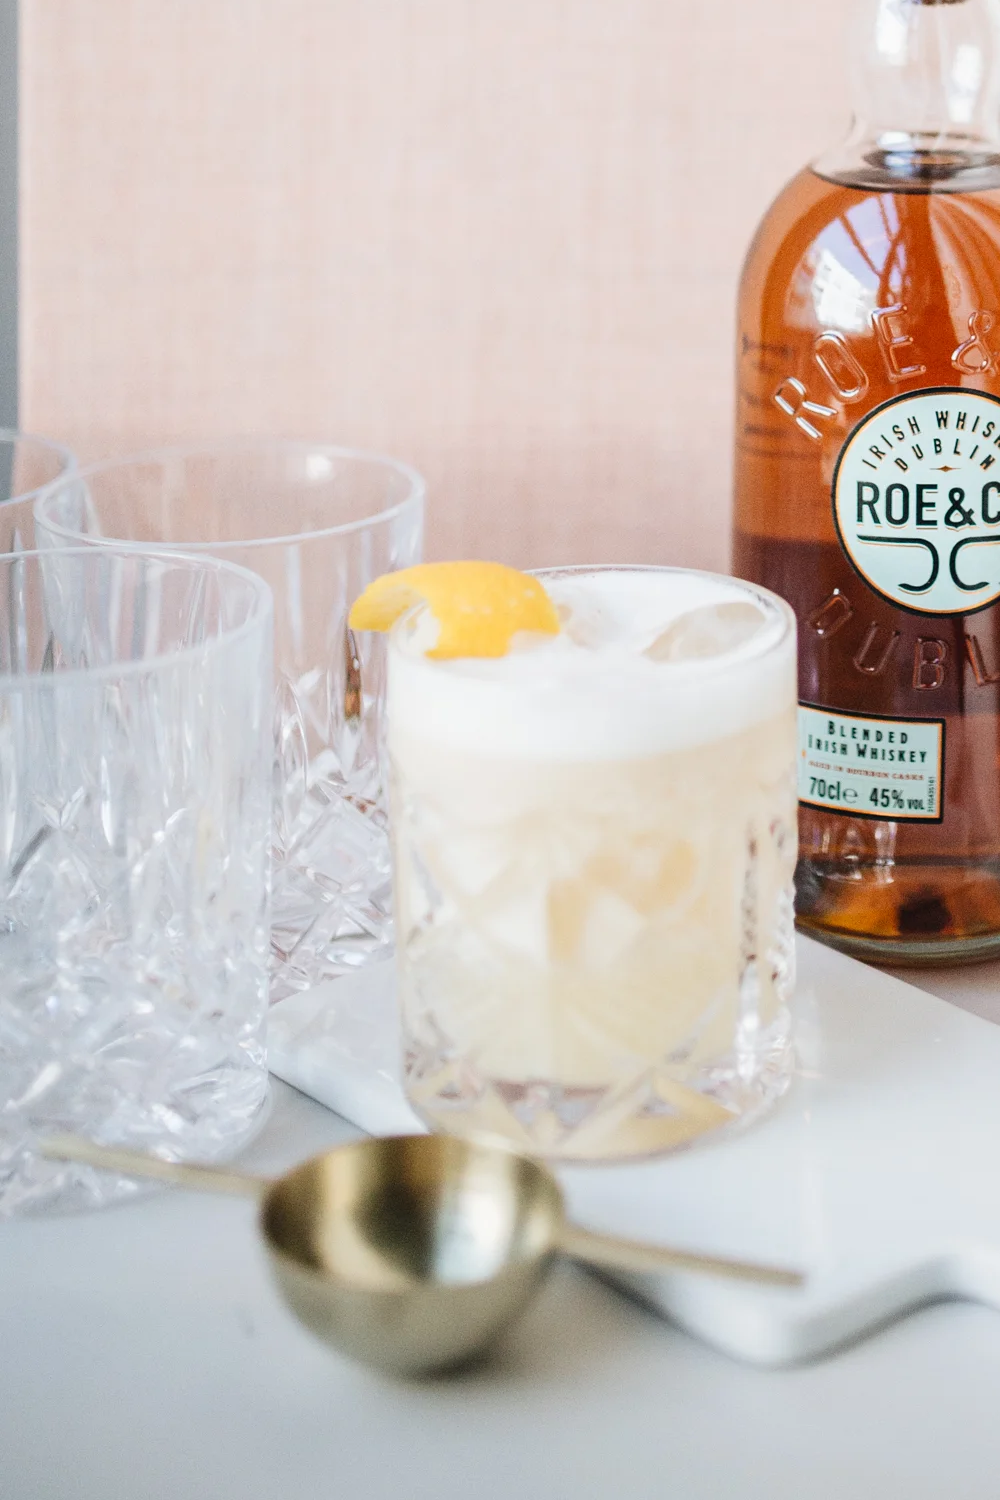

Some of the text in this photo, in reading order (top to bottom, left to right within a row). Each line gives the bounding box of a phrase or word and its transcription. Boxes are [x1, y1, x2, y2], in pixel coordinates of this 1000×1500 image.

[773, 302, 927, 440] ROE
[951, 310, 998, 377] &
[862, 415, 921, 470] IRISH
[894, 438, 996, 473] DUBLIN
[827, 720, 908, 744] BLENDED
[808, 734, 927, 763] IRISH WHISKEY
[869, 787, 905, 809] 45%
